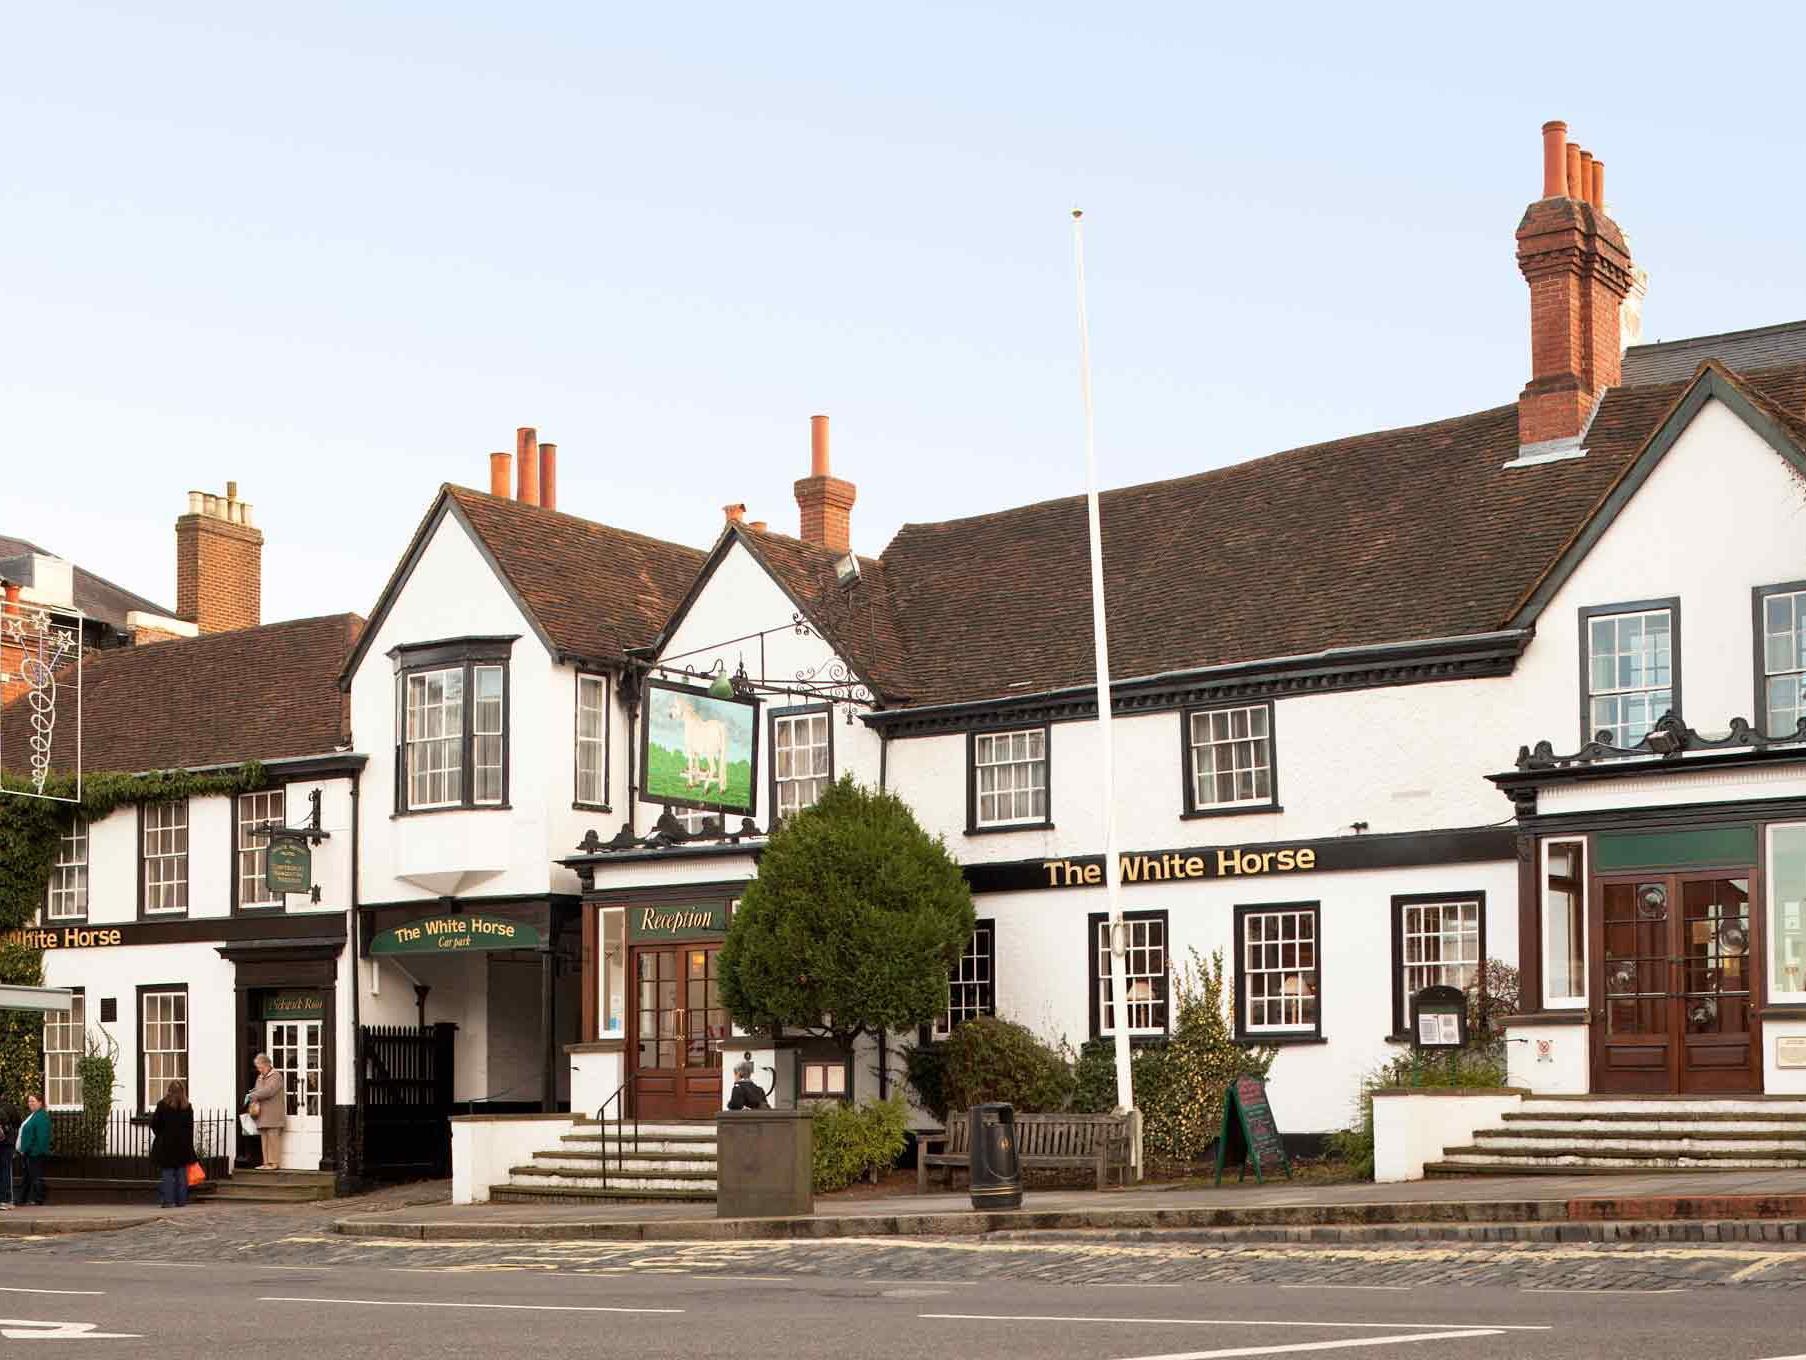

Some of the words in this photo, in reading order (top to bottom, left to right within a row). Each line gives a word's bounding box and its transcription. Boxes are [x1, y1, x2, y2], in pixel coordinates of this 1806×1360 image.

[1043, 860, 1101, 886] The
[1120, 853, 1204, 881] White
[1216, 848, 1316, 876] Horse
[395, 928, 421, 944] The
[425, 919, 467, 936] White
[471, 918, 515, 937] Horse
[641, 905, 712, 933] Reception
[64, 928, 121, 948] Horse
